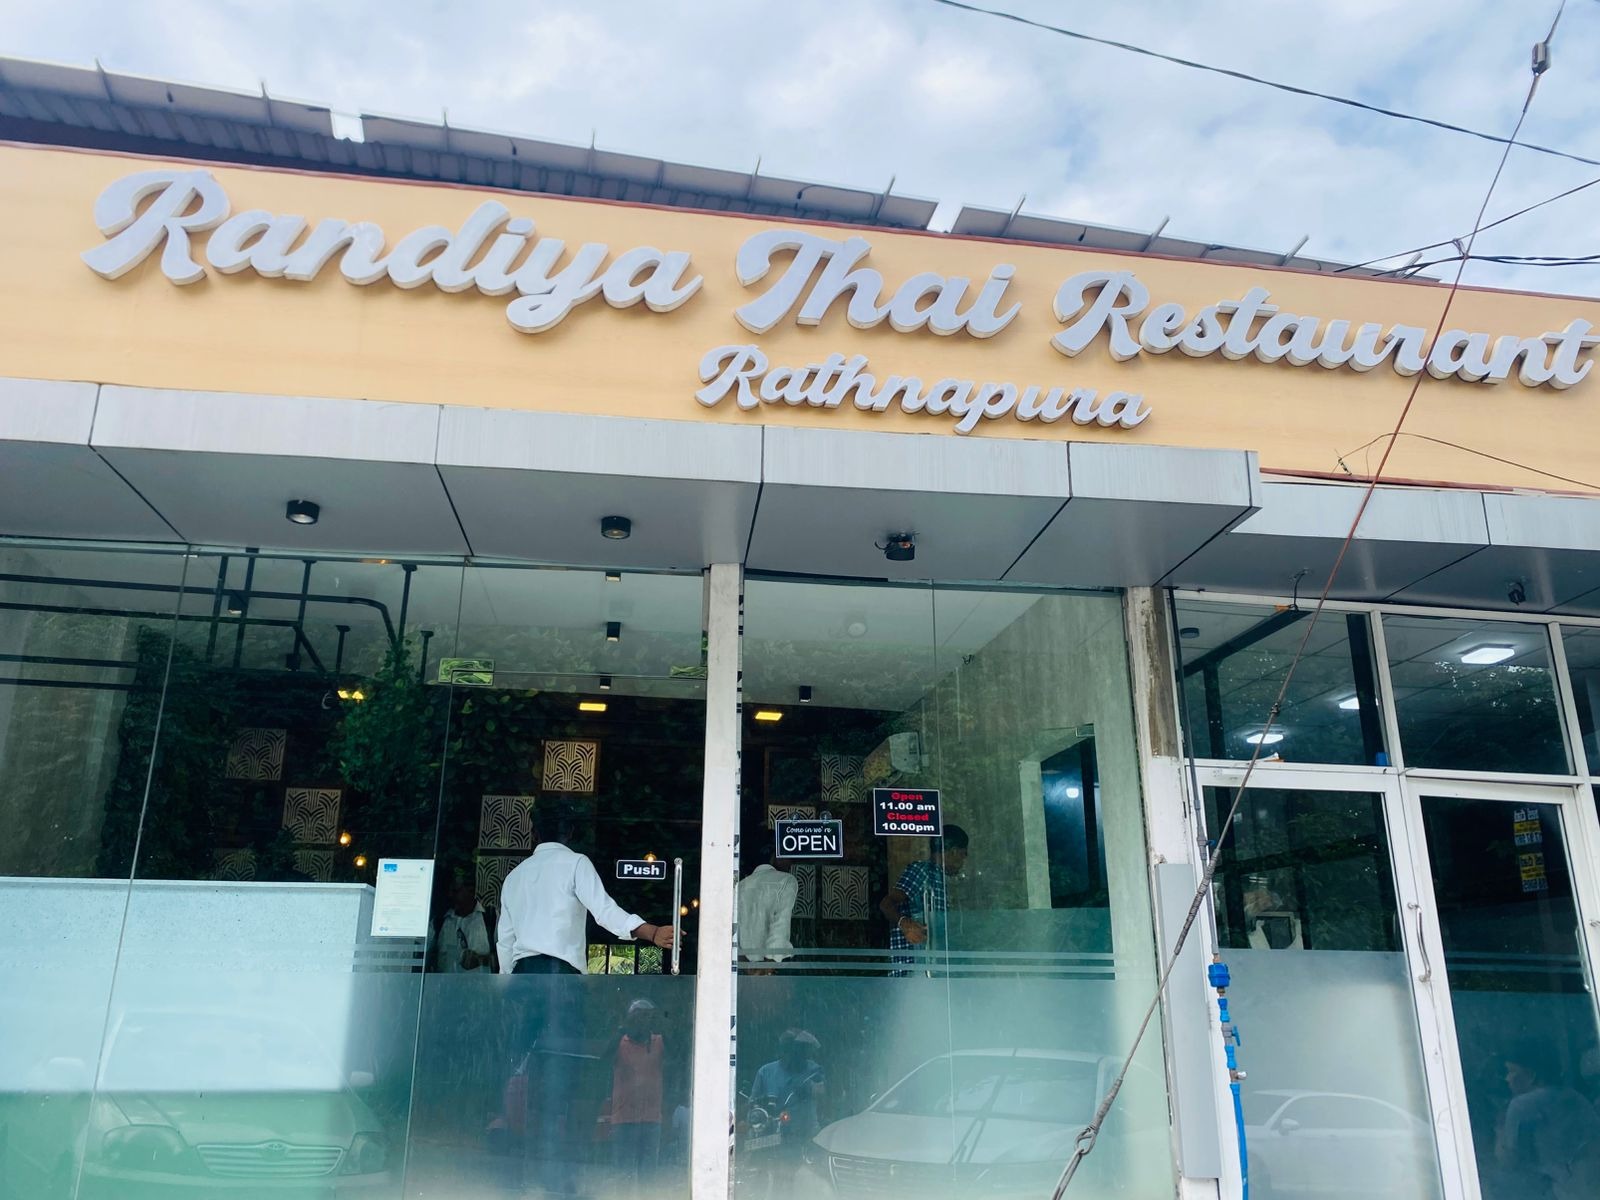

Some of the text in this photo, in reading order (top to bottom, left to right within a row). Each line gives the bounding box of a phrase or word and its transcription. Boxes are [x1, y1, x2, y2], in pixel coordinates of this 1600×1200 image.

[80, 169, 1600, 390] Randiya Thai Restaurant
[695, 343, 1152, 436] Rathnapura
[891, 792, 923, 801] Open
[880, 802, 914, 810] 11.00
[887, 812, 929, 821] Closed
[882, 822, 935, 832] 10.00pm
[782, 835, 837, 851] OPEN
[623, 863, 660, 876] Push
